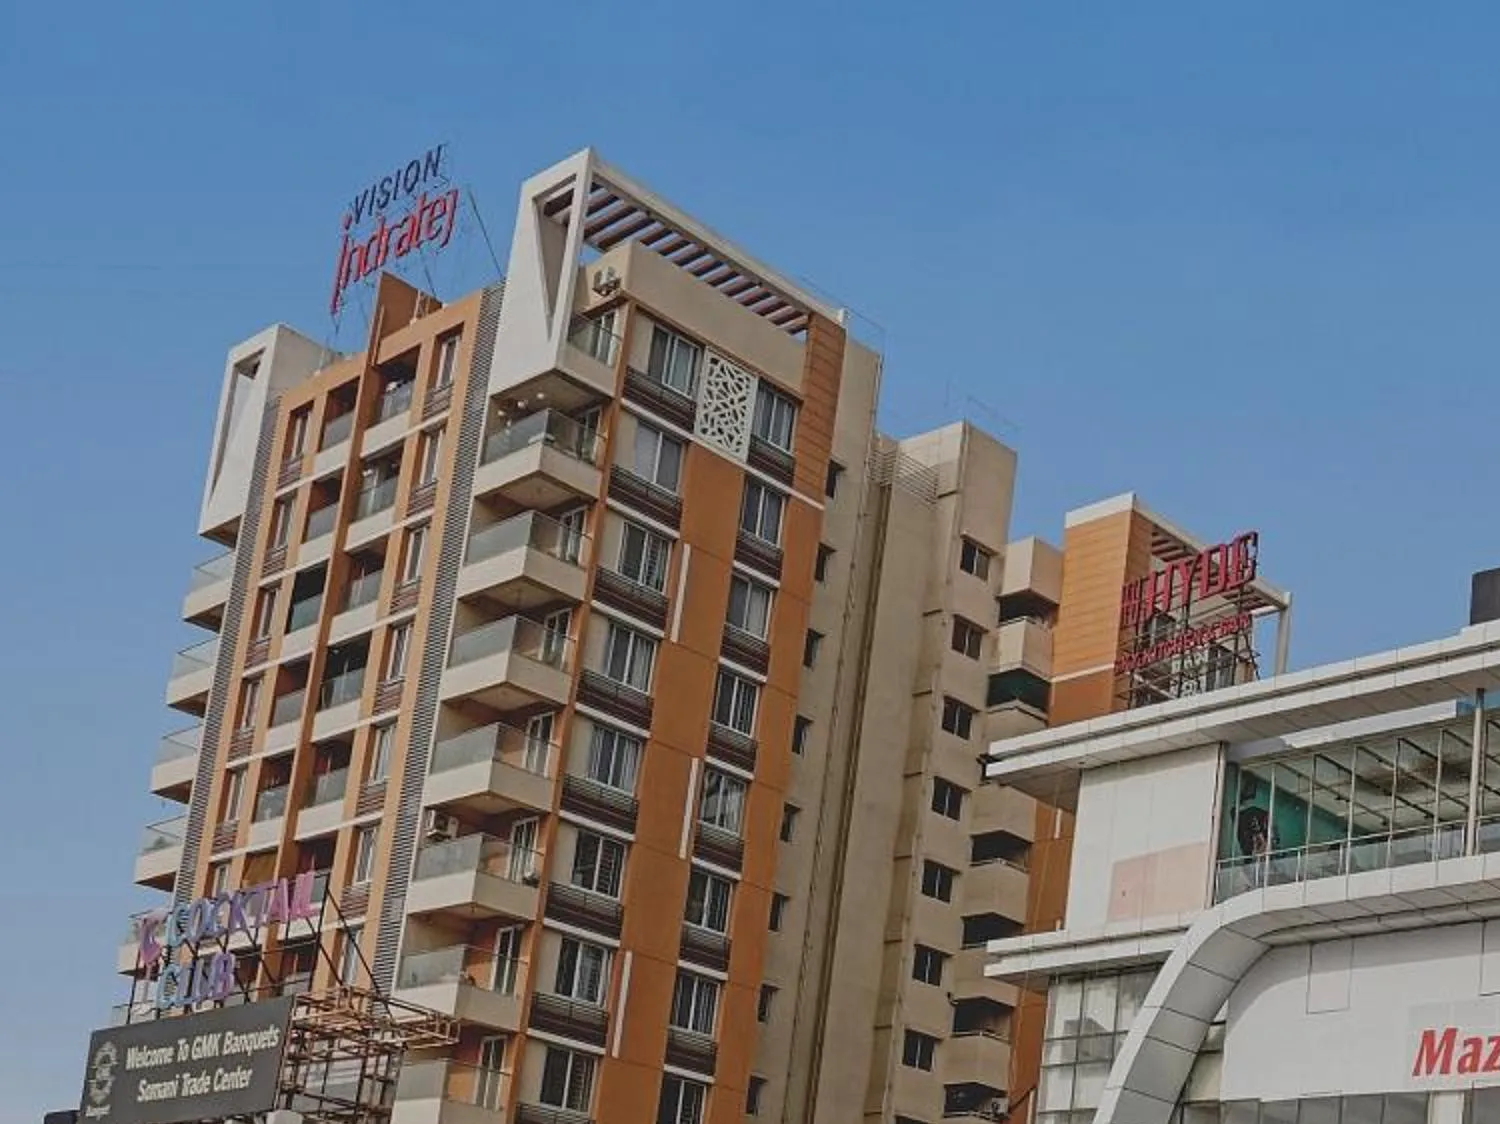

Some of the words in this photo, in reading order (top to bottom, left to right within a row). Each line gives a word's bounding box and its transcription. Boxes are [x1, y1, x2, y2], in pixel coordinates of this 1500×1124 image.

[353, 144, 442, 224] VISION
[125, 1046, 174, 1071] Welcome
[177, 1038, 190, 1062] To
[191, 1032, 222, 1061] GMK
[223, 1024, 282, 1057] Banquets
[181, 1070, 211, 1097] Trade
[213, 1065, 254, 1093] Center
